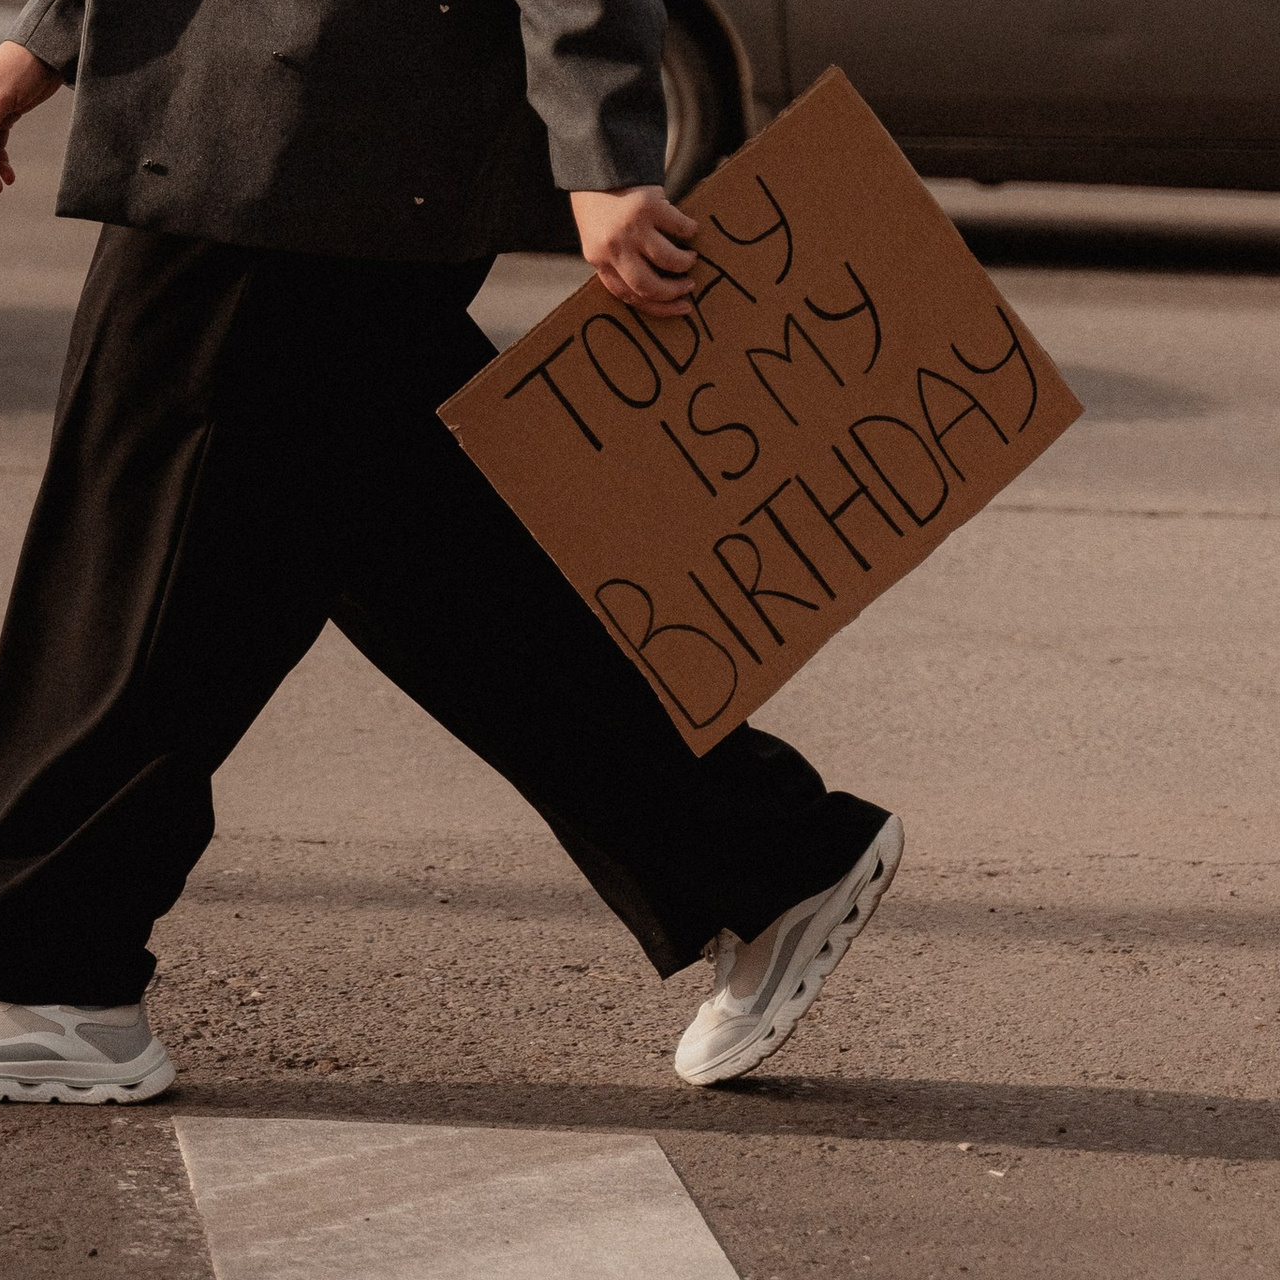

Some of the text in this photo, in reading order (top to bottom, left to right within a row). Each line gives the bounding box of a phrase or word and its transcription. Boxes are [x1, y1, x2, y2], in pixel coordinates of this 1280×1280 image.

[593, 304, 1039, 730] BIRTHDAY
[659, 260, 883, 499] IS MY
